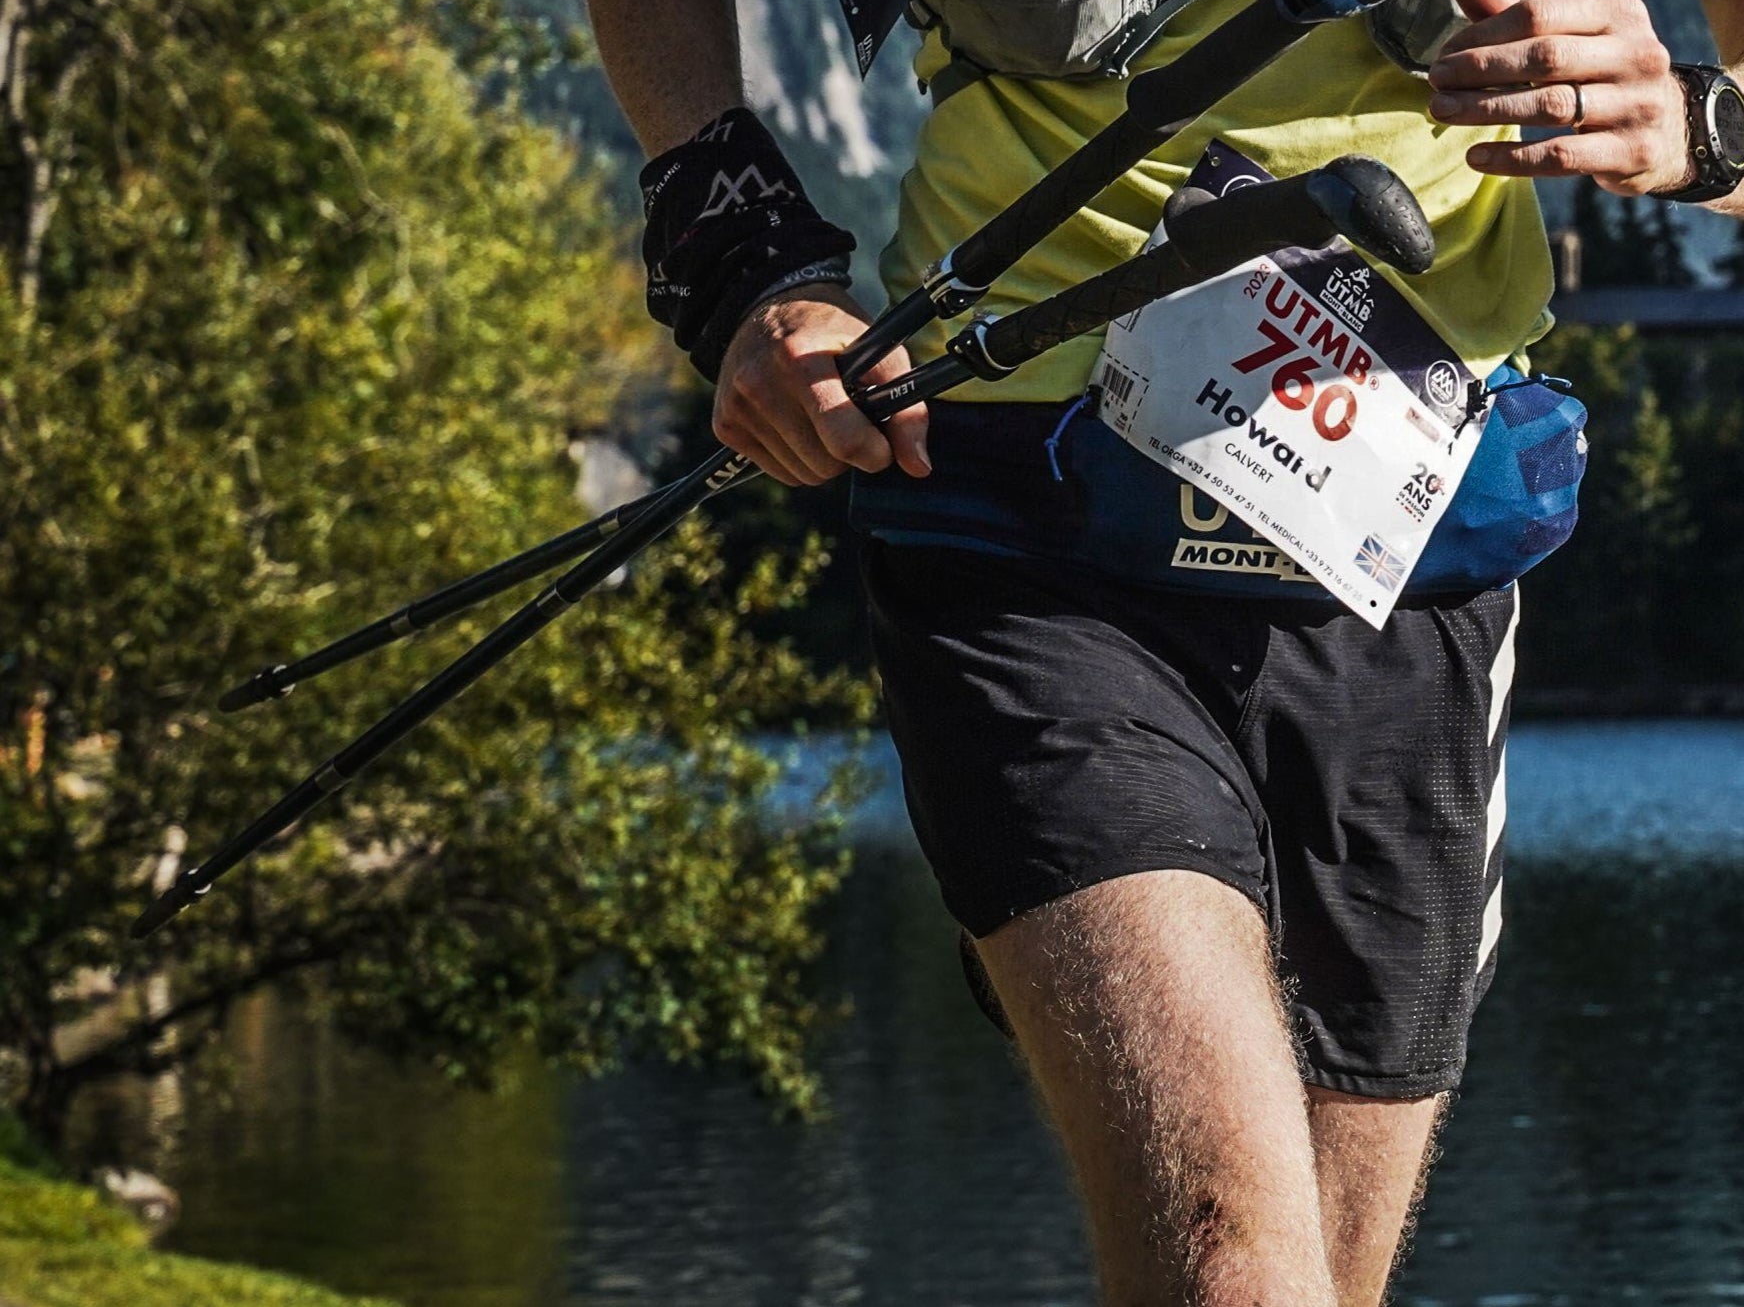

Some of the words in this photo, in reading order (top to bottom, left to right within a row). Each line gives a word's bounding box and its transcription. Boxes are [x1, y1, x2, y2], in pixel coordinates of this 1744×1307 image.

[1243, 263, 1272, 299] 2023
[889, 380, 915, 400] LEKI
[1231, 318, 1357, 441] 760
[1195, 378, 1332, 493] Howard
[1225, 442, 1275, 484] CALVERT
[1148, 436, 1160, 450] TEL
[1162, 445, 1186, 466] ORGA
[1187, 460, 1204, 476] +33
[1204, 471, 1211, 480] 4
[1211, 476, 1224, 488] 50
[1223, 484, 1235, 496] 53
[1234, 493, 1246, 504] 47
[1245, 501, 1256, 512] 51
[1258, 511, 1270, 524] TEL
[1271, 522, 1304, 552] MEDICAL
[1403, 482, 1433, 511] ANS
